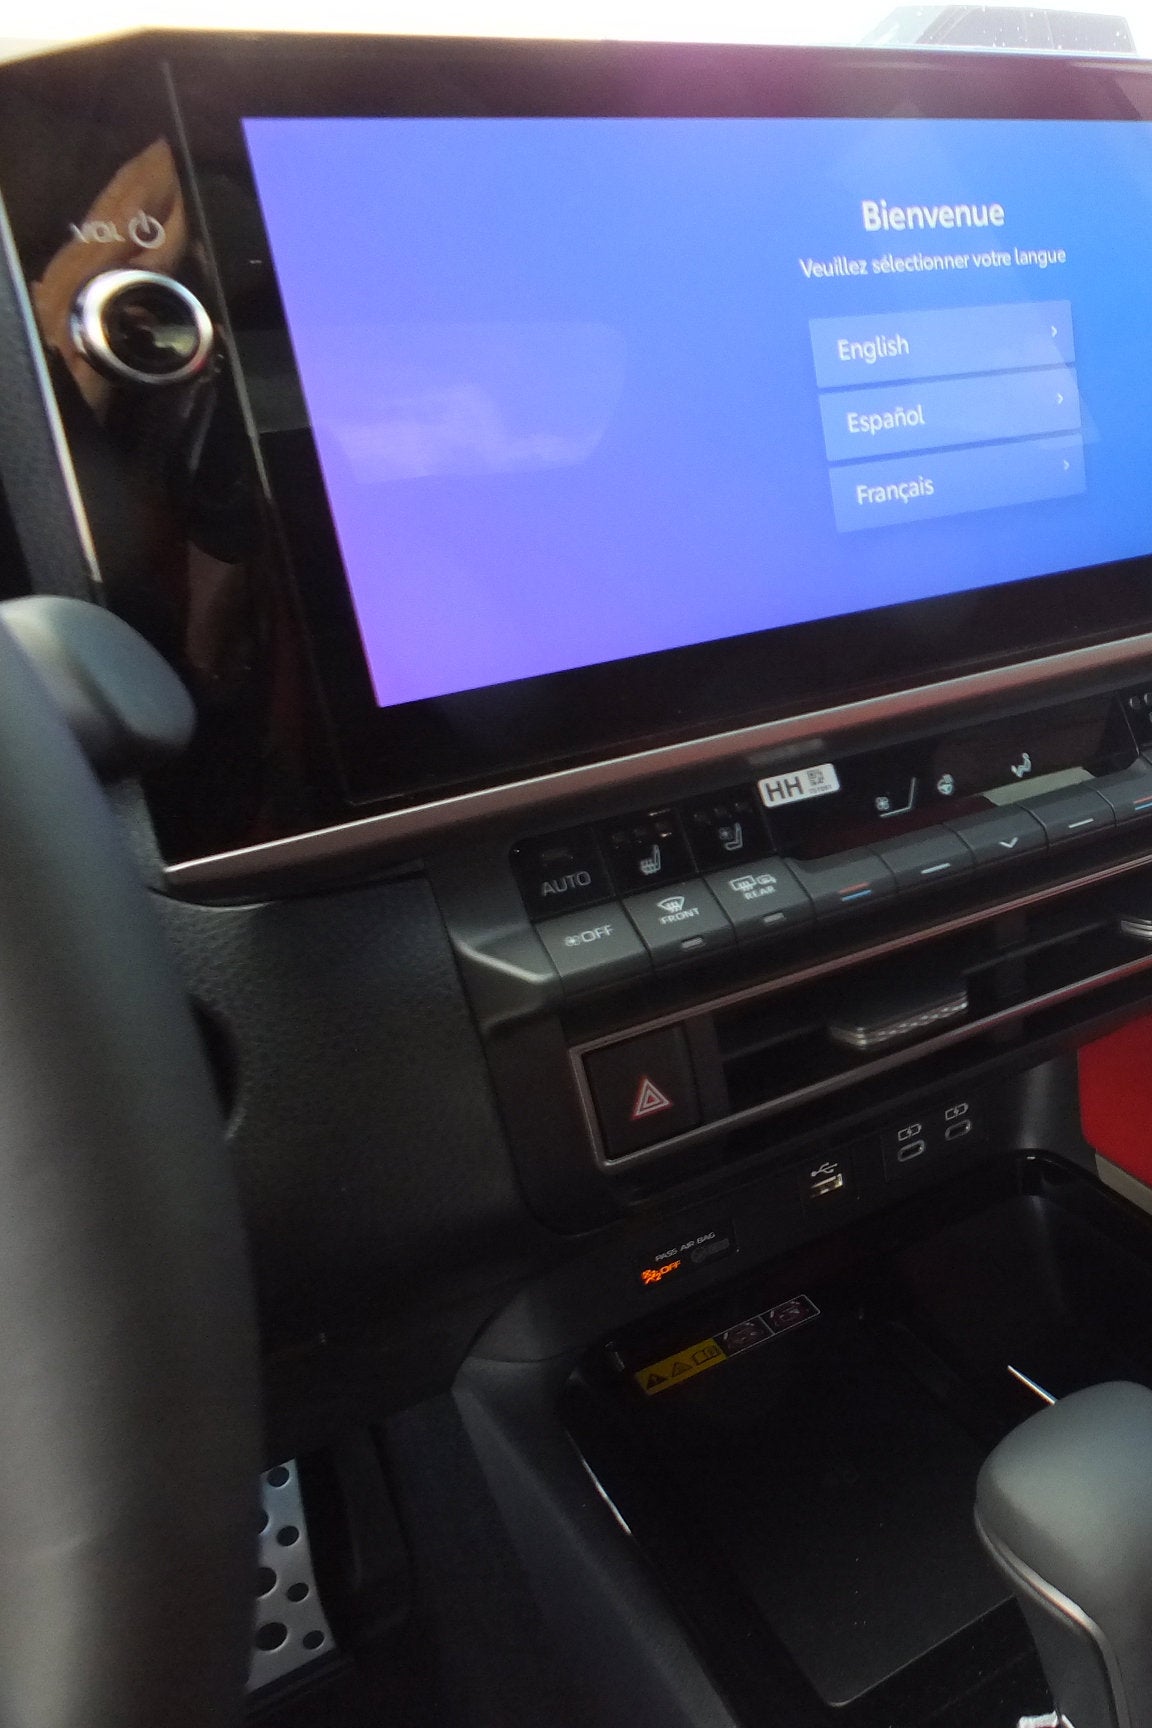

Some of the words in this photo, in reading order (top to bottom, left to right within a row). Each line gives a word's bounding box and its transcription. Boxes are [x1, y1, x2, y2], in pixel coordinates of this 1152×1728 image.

[861, 199, 1005, 232] Bienvenue
[70, 222, 126, 244] VOL
[799, 256, 868, 278] Veuillez
[872, 252, 970, 274] sélectionner
[973, 251, 1011, 268] votre
[1014, 247, 1067, 269] langue
[837, 334, 910, 364] English
[847, 404, 926, 435] Español
[856, 476, 935, 504] Français
[765, 776, 804, 801] HH
[541, 871, 592, 896] AUTO
[745, 885, 777, 900] REAR
[660, 906, 700, 924] FRONT
[581, 924, 614, 943] OFF
[680, 1240, 695, 1251] AIR
[696, 1231, 716, 1244] BAG
